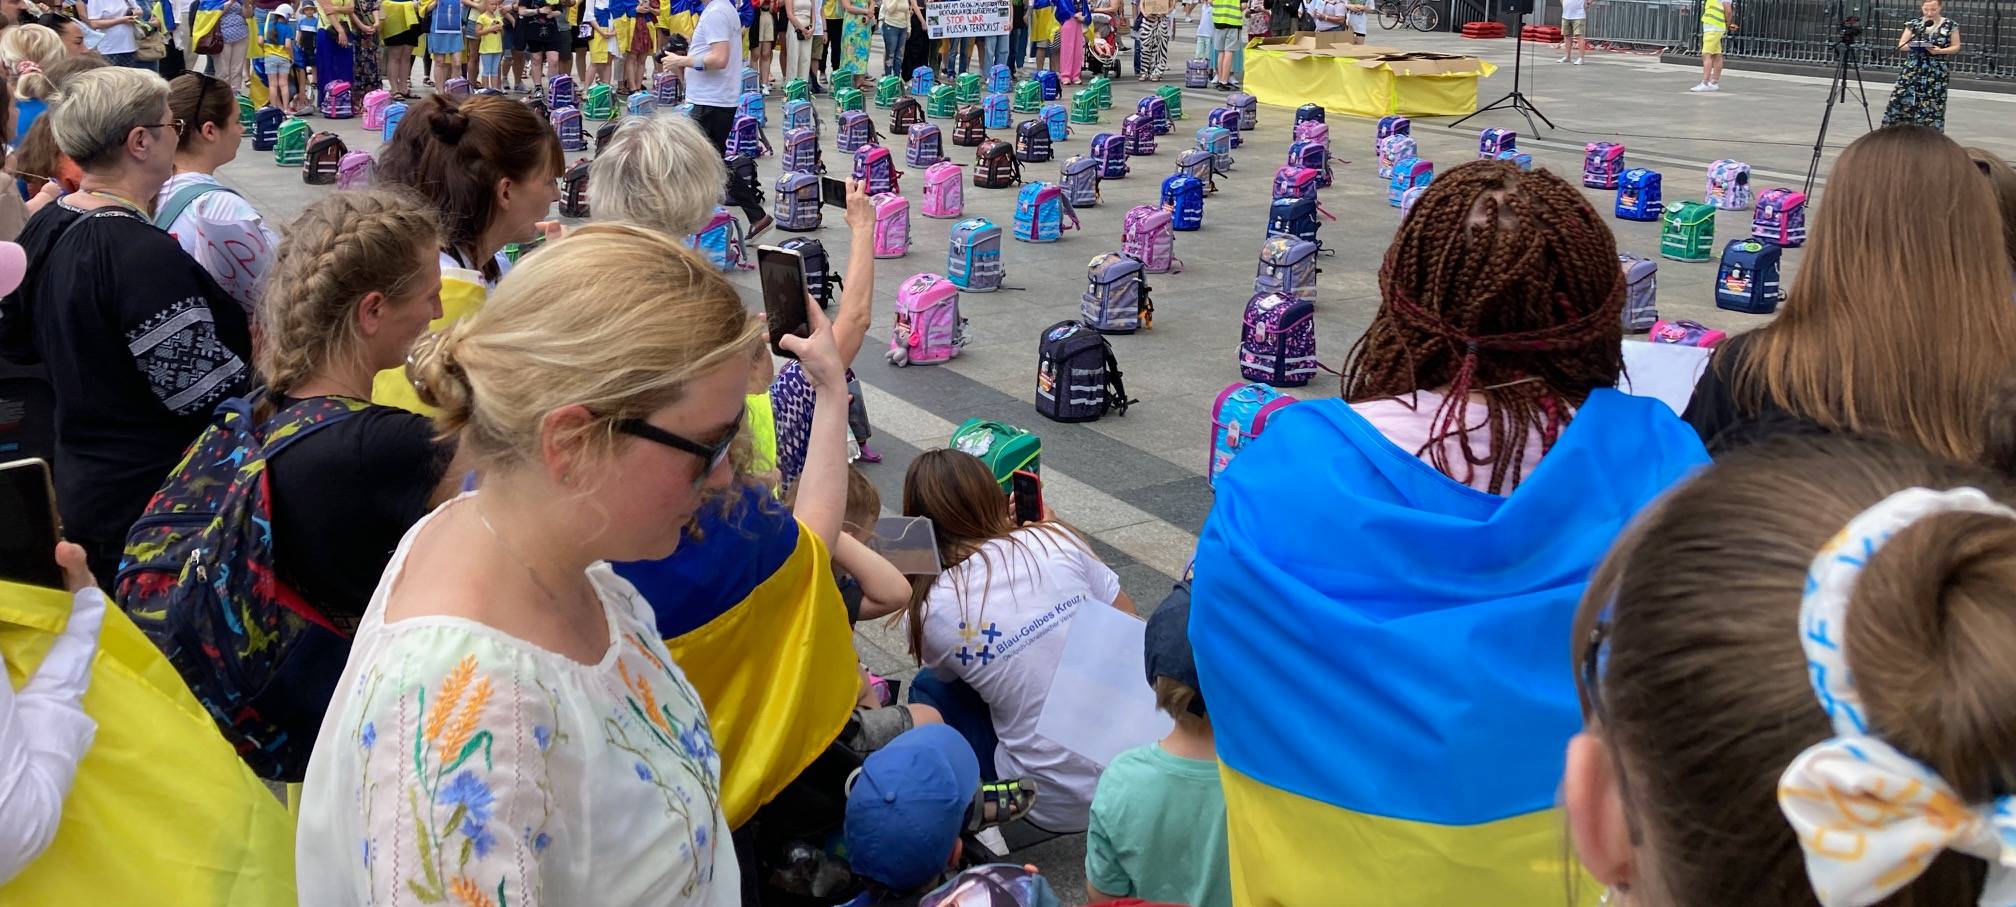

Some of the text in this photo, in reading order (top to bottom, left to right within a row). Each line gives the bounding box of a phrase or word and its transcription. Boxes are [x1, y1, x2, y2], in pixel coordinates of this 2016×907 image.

[946, 15, 983, 24] STOP WAR
[946, 25, 968, 33] RUSSIA
[969, 22, 1000, 32] TERRORIST
[996, 595, 1080, 653] Blau-Gelbes Kreuz
